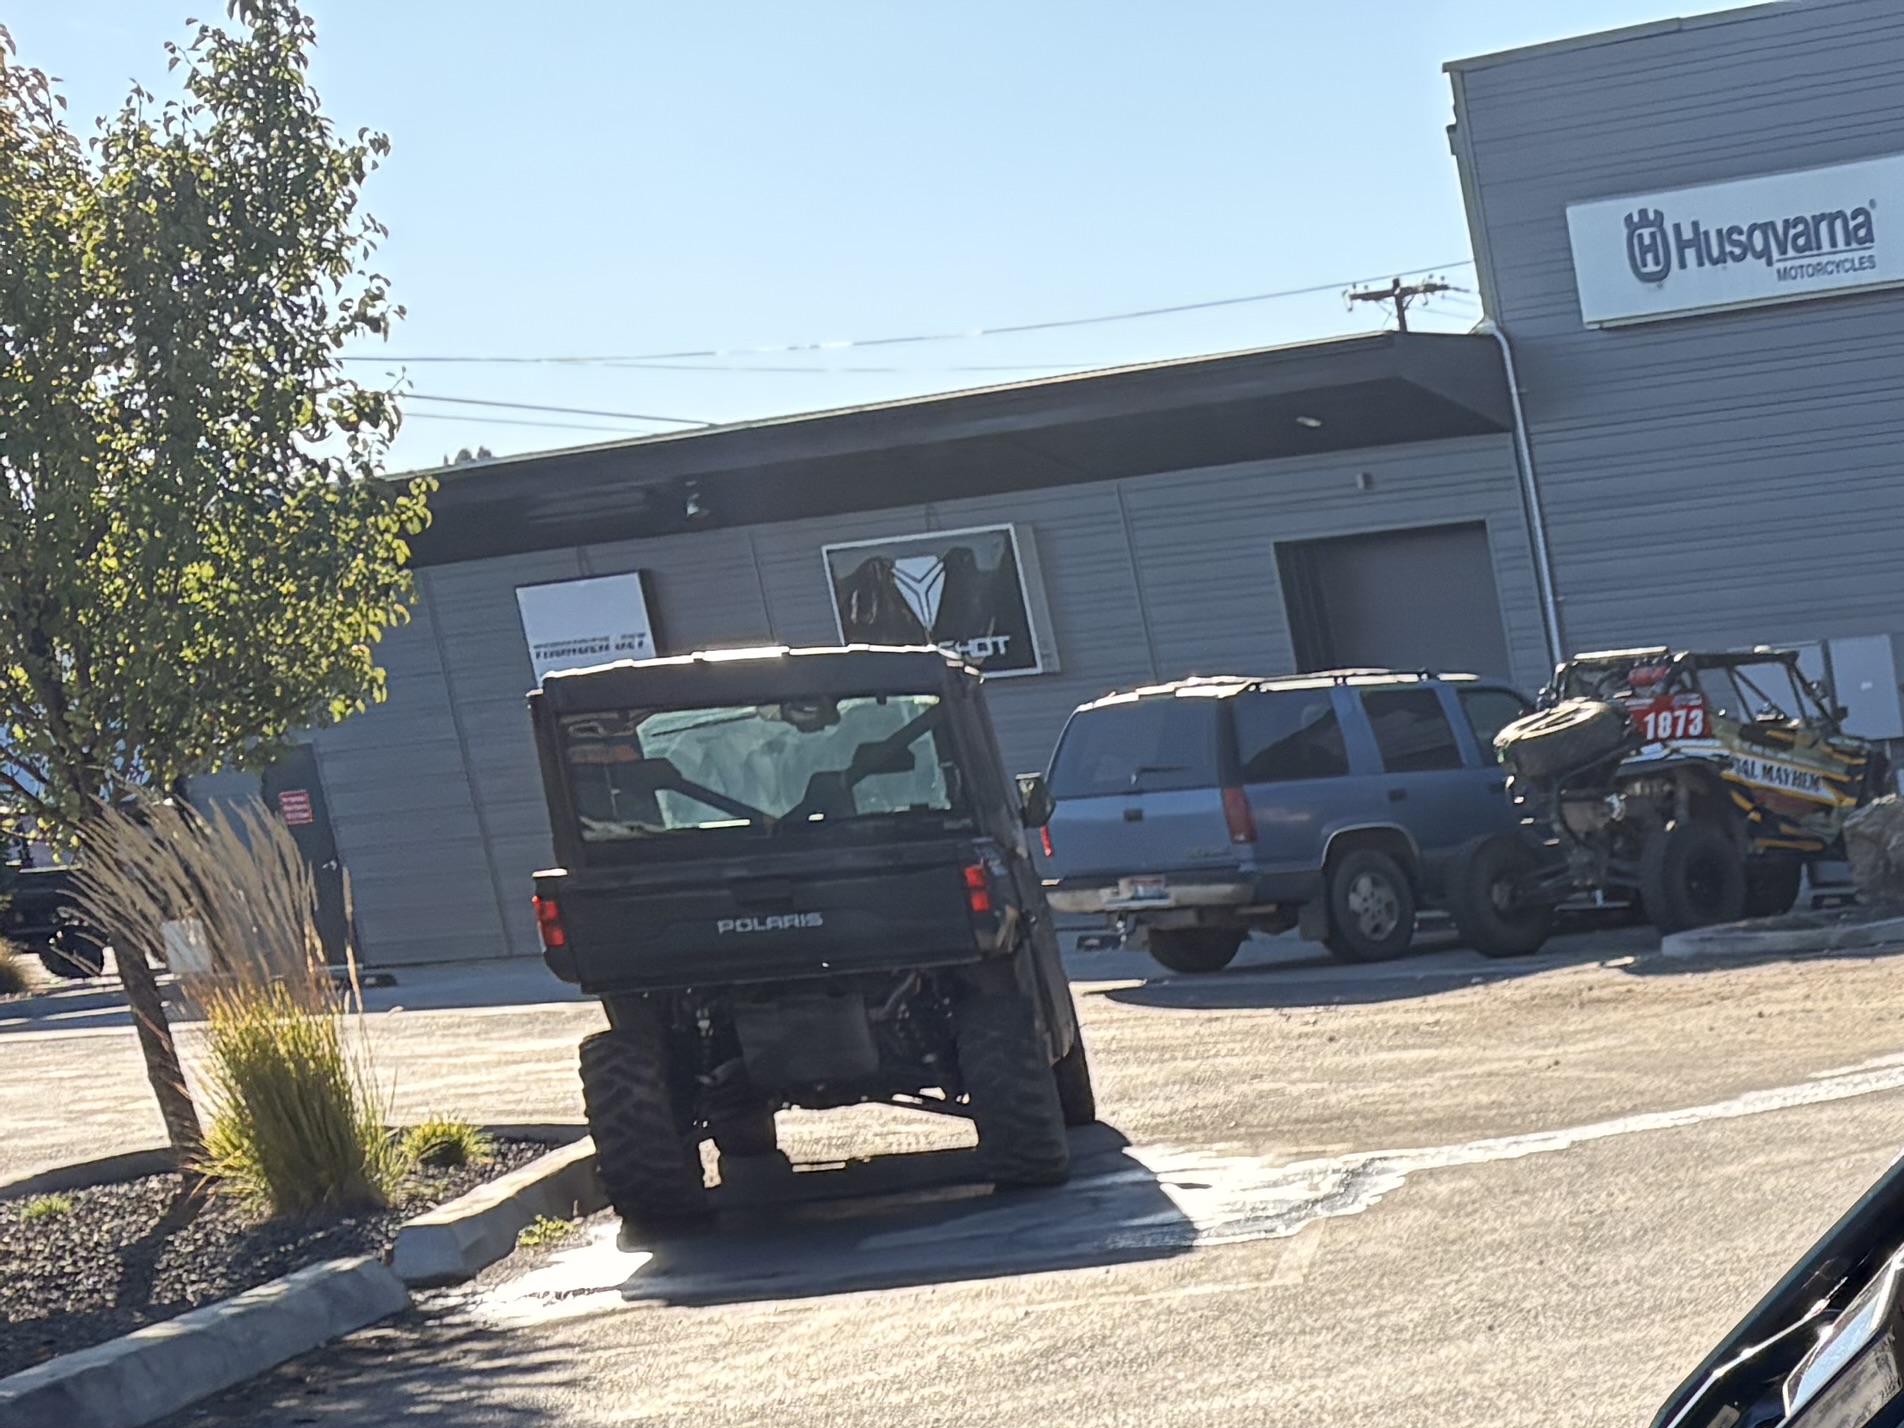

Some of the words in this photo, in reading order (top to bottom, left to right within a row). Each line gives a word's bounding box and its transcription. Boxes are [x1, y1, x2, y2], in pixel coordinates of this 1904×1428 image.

[1672, 206, 1875, 270] Husqvarna
[1776, 254, 1876, 282] MOTORCYCLES
[1644, 709, 1704, 740] 1873
[718, 912, 823, 934] POLARIS
